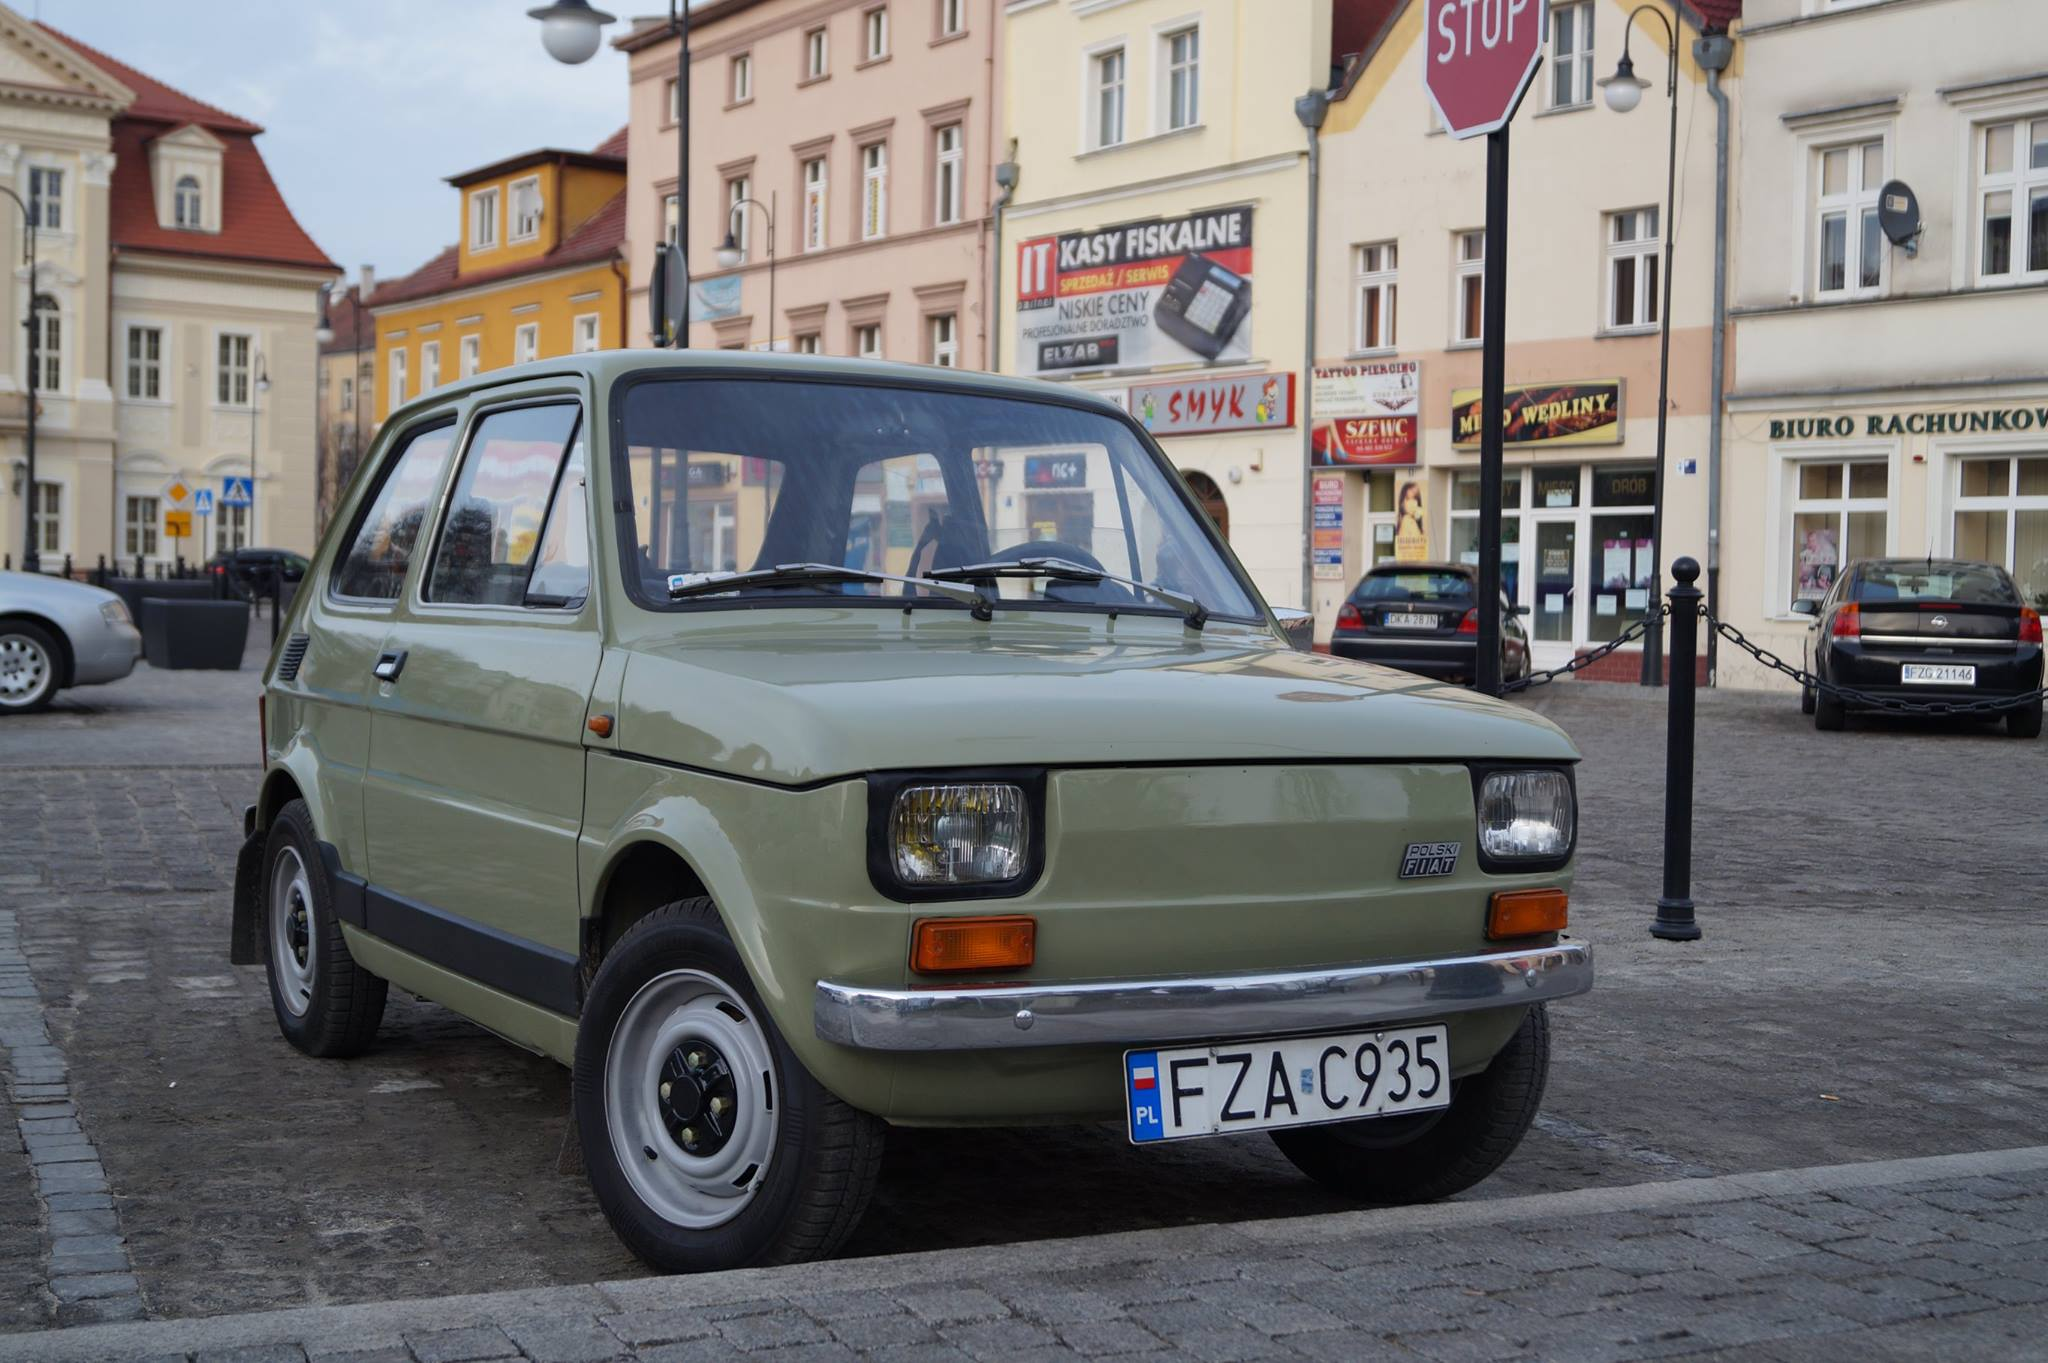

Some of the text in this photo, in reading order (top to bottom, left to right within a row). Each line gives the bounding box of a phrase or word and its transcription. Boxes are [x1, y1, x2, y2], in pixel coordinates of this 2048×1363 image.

[1437, 0, 1527, 64] STOP
[1060, 213, 1241, 268] KASY FISKALNE
[1021, 243, 1050, 295] IT
[1060, 269, 1114, 293] SPRZEDAŻ
[1126, 264, 1169, 284] SERWIS
[1058, 290, 1150, 320] NISKIE CENY
[1022, 315, 1149, 339] PROFESJONALNE DORADZTWO
[1043, 343, 1099, 363] ELZAB
[1314, 362, 1416, 379] TATTOO PIERCING
[1168, 383, 1245, 424] SMYK
[1459, 393, 1610, 434] MIO WĘDLINY
[1345, 418, 1408, 438] SZEWC
[1769, 415, 1854, 439] BIURO
[1910, 666, 1972, 681] FZG 21146
[1410, 844, 1458, 857] POLSKI
[1405, 858, 1455, 875] FIAT
[1170, 1035, 1440, 1127] FZA C935
[1136, 1107, 1158, 1126] PL
